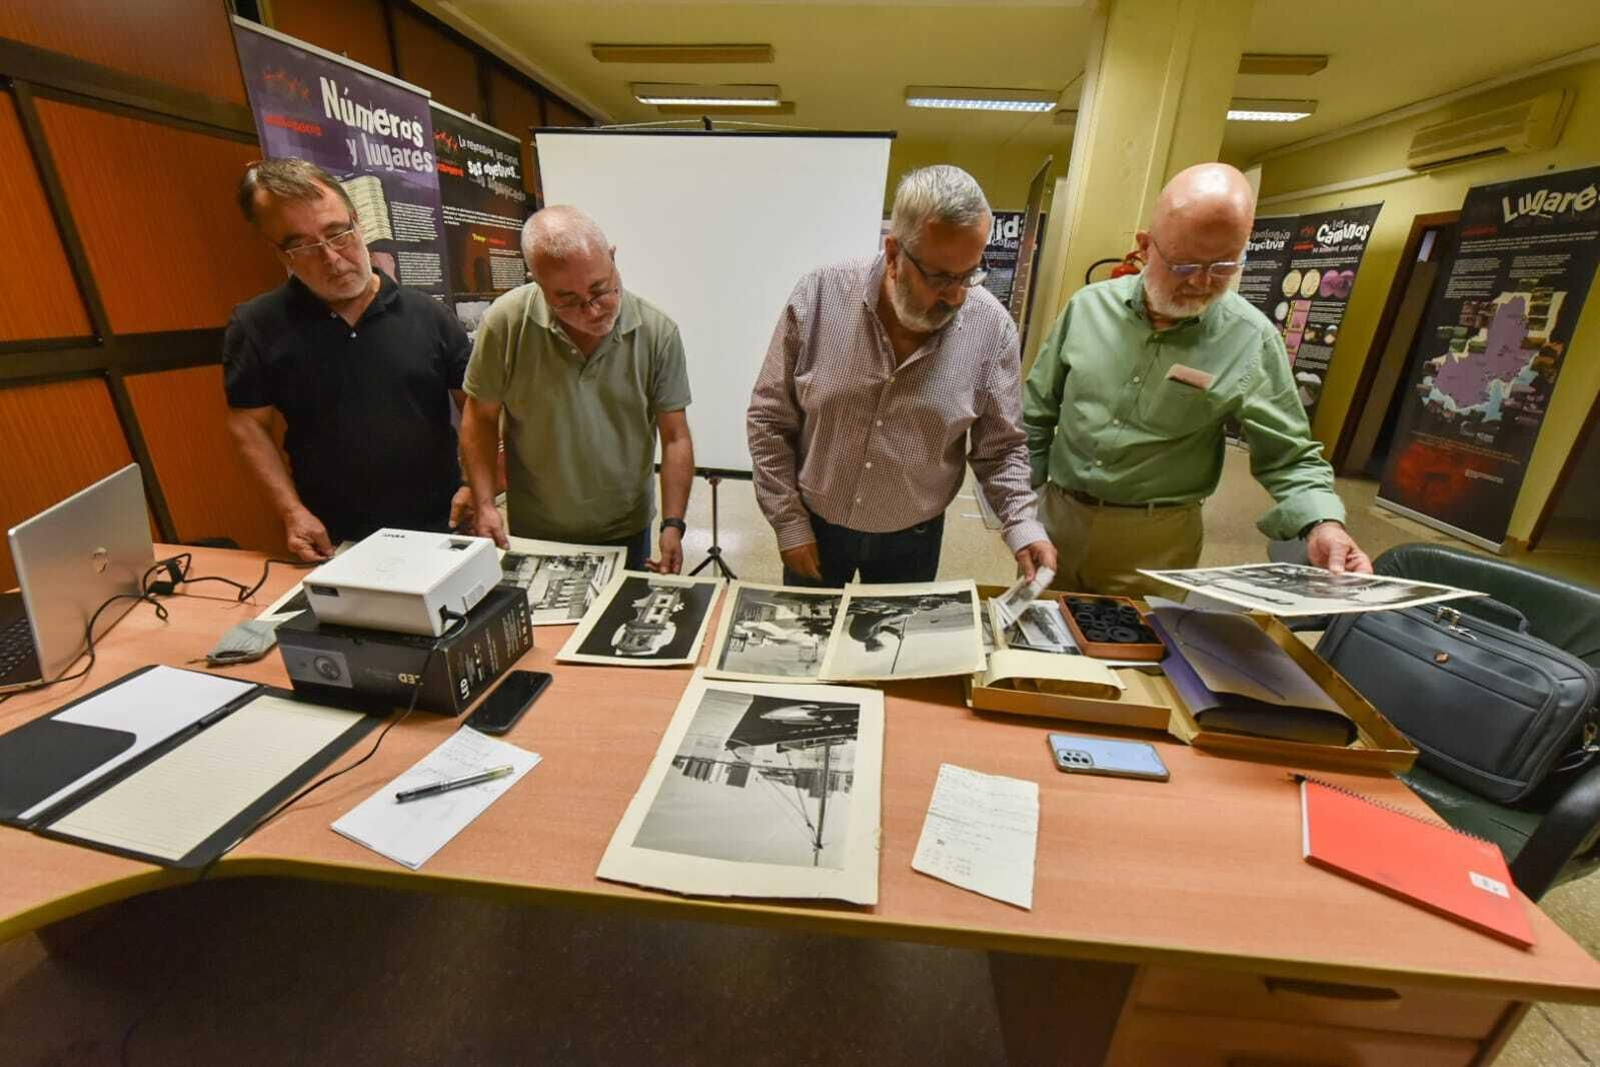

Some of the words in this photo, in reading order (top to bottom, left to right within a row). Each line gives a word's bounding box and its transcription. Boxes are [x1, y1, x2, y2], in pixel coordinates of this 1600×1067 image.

[319, 76, 424, 148] Números
[345, 138, 357, 167] y
[361, 132, 433, 172] lugares
[1502, 183, 1600, 224] Lugare
[1316, 223, 1370, 244] Caminos
[460, 678, 470, 700] LED
